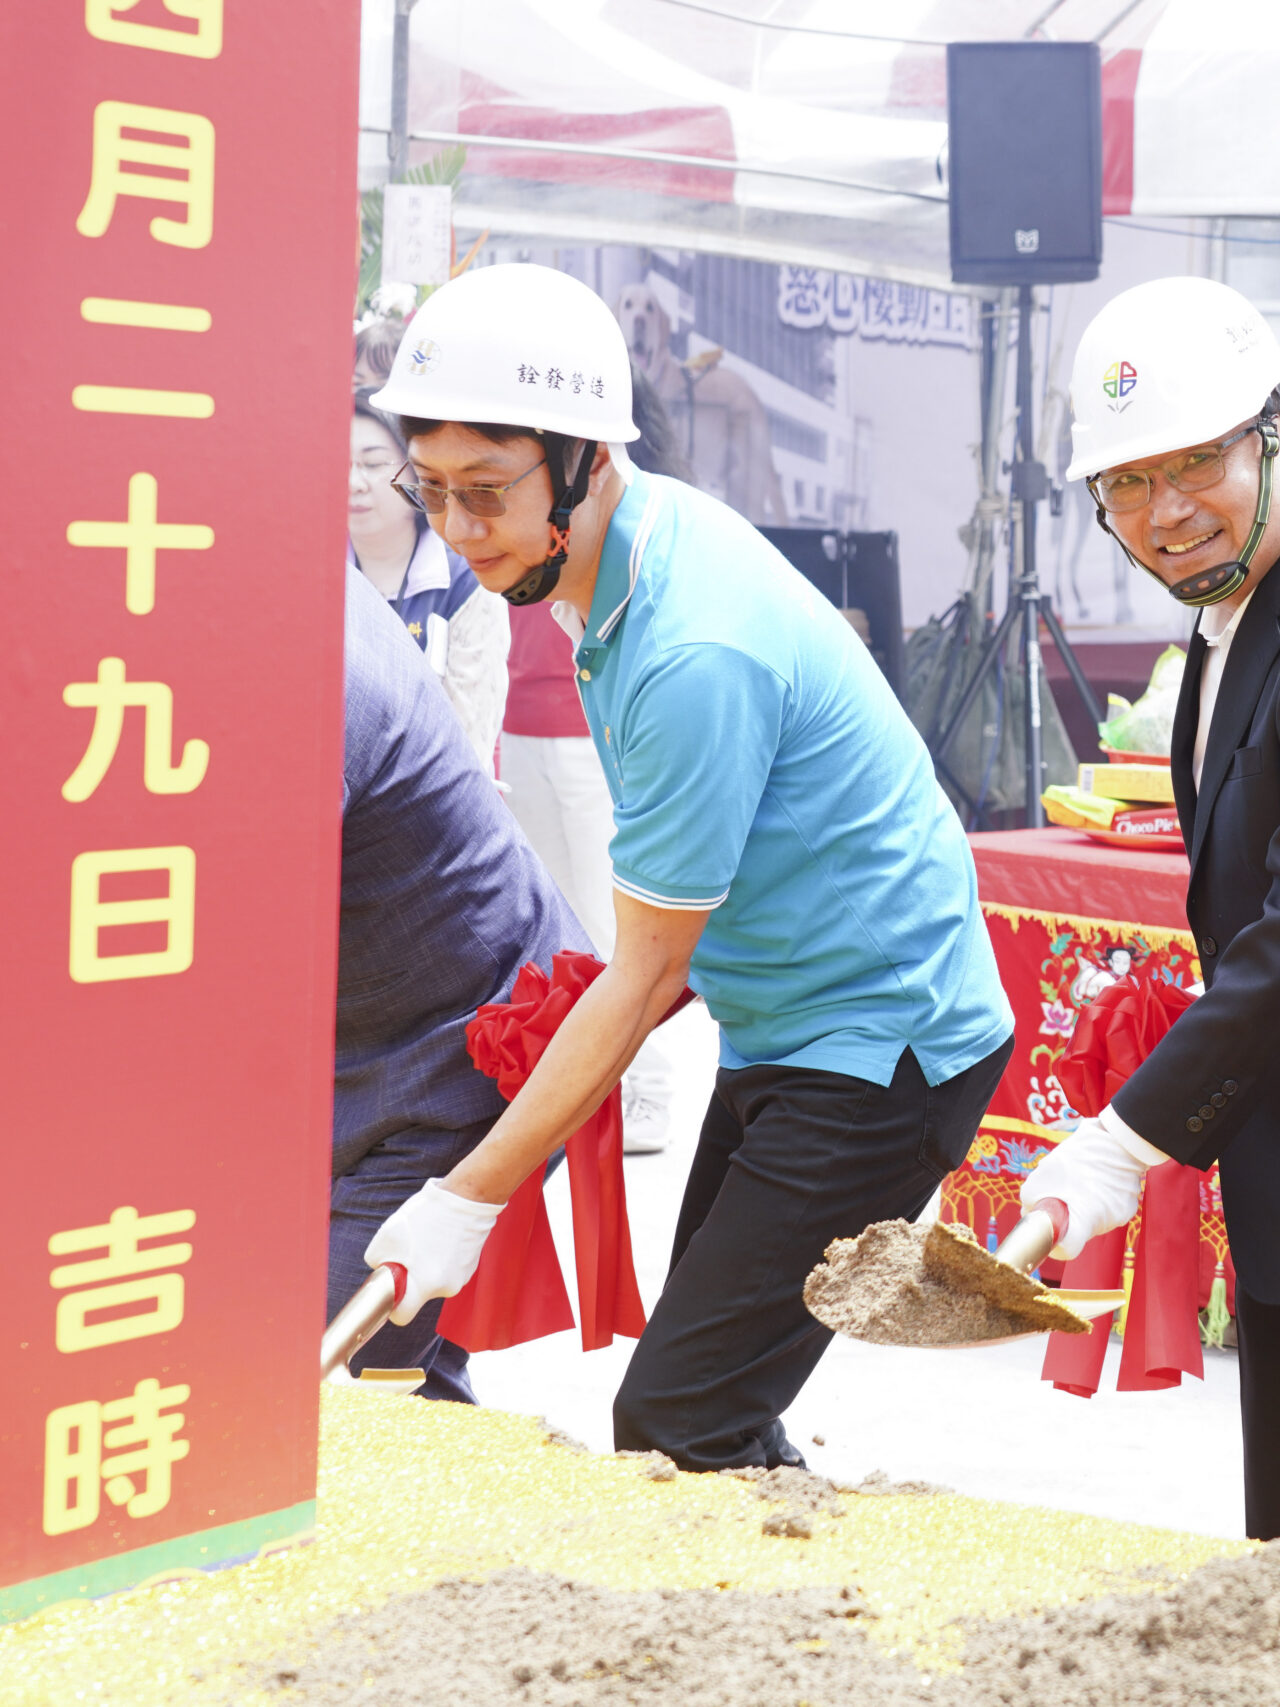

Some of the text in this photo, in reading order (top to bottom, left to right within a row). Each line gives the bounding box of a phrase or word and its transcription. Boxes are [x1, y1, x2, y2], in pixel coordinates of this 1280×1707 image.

[516, 363, 604, 399] 詮發營造
[43, 1207, 195, 1535] 吉時
